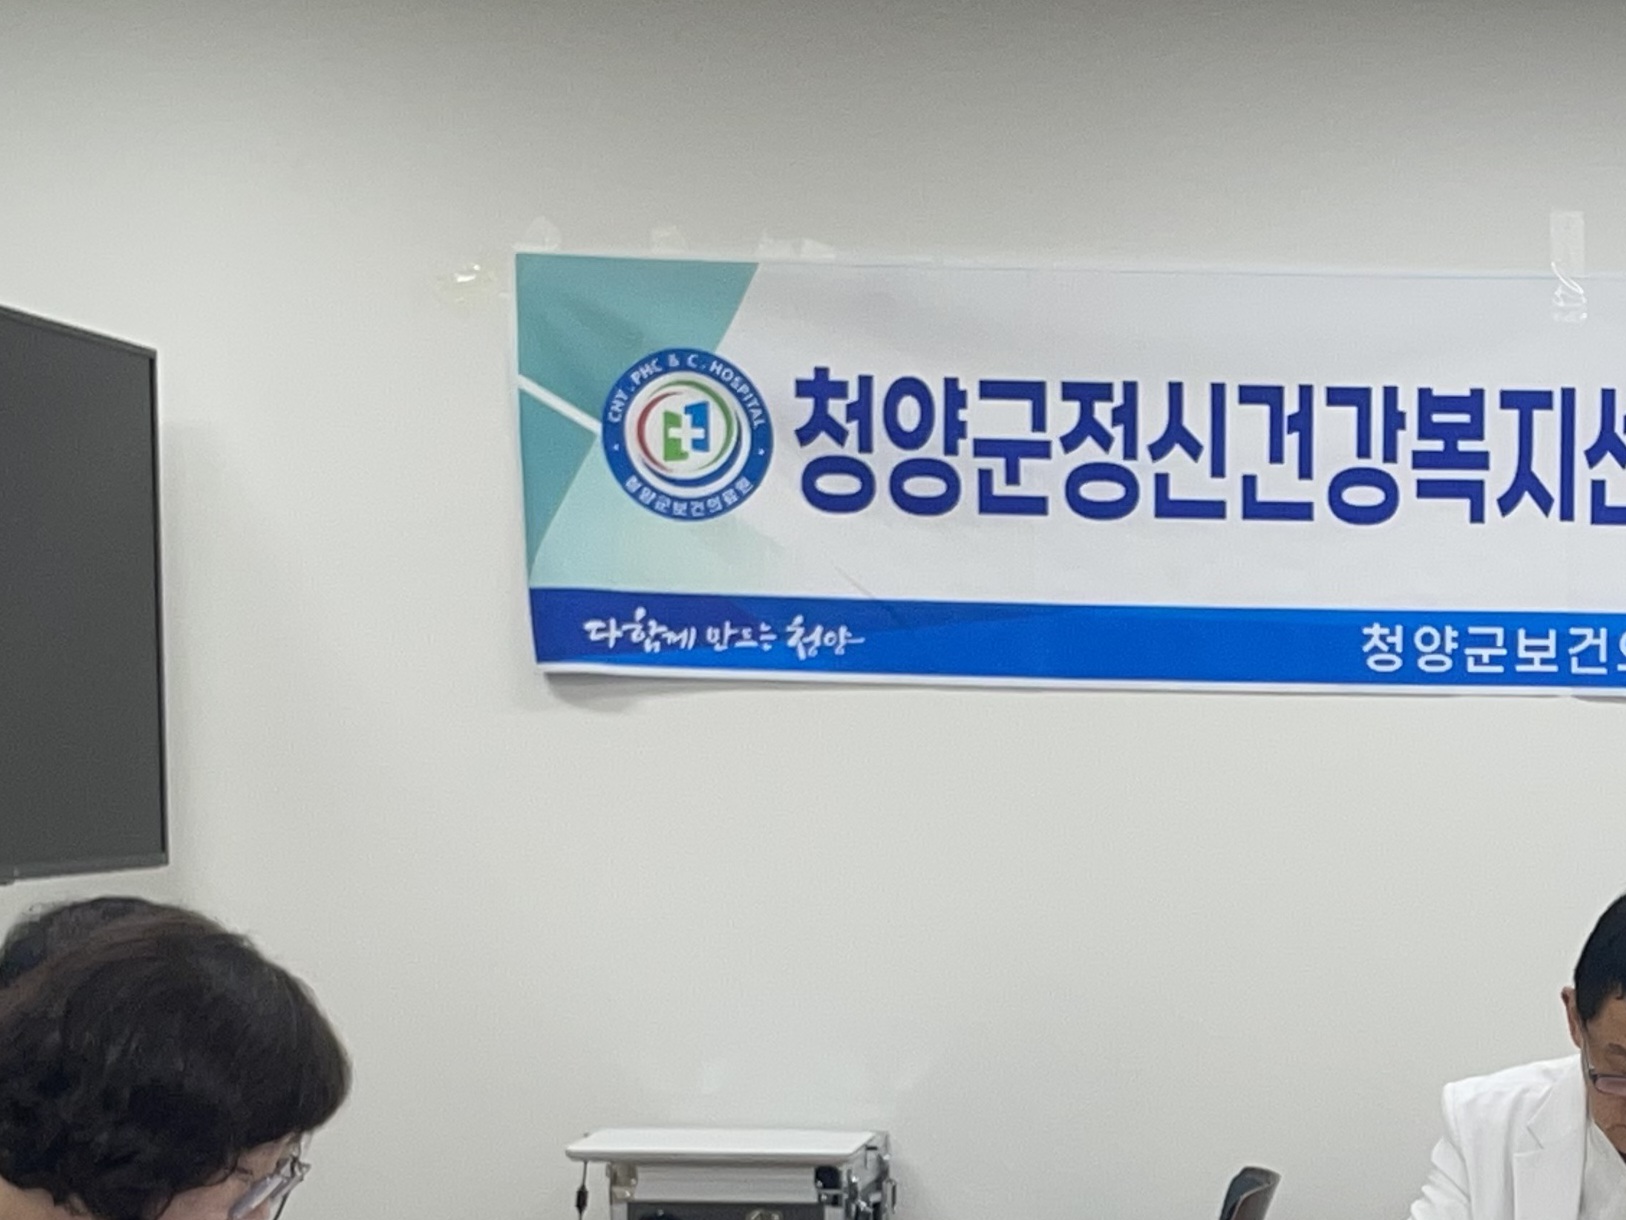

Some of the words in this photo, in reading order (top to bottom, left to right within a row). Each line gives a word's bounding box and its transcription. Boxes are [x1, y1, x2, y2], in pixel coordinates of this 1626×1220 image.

[667, 354, 680, 367] &
[709, 360, 766, 428] HOSPITAL
[583, 606, 697, 653] 다함께
[706, 620, 777, 652] 만드는
[786, 615, 865, 661] 청양
